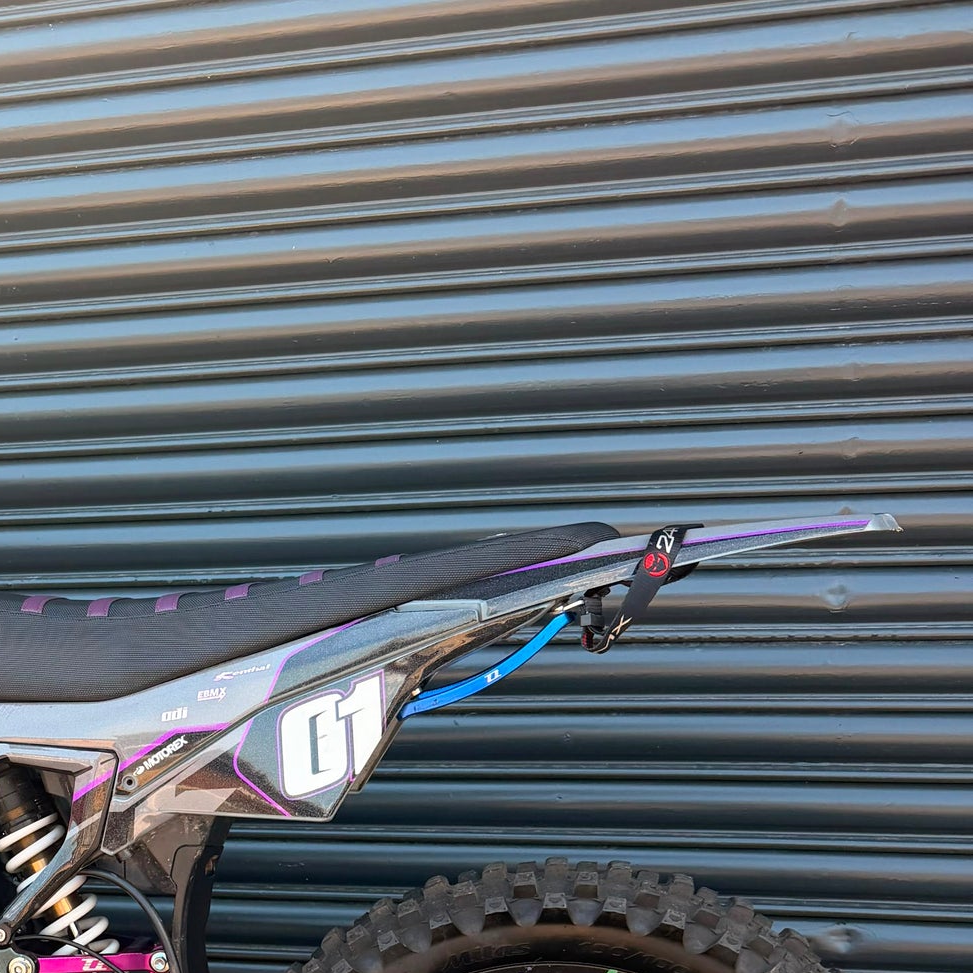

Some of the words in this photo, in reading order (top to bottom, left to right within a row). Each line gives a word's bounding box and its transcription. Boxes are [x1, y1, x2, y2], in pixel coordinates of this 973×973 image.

[197, 686, 227, 703] EBMX
[142, 734, 189, 770] MOTOREX
[280, 675, 383, 797] 01
